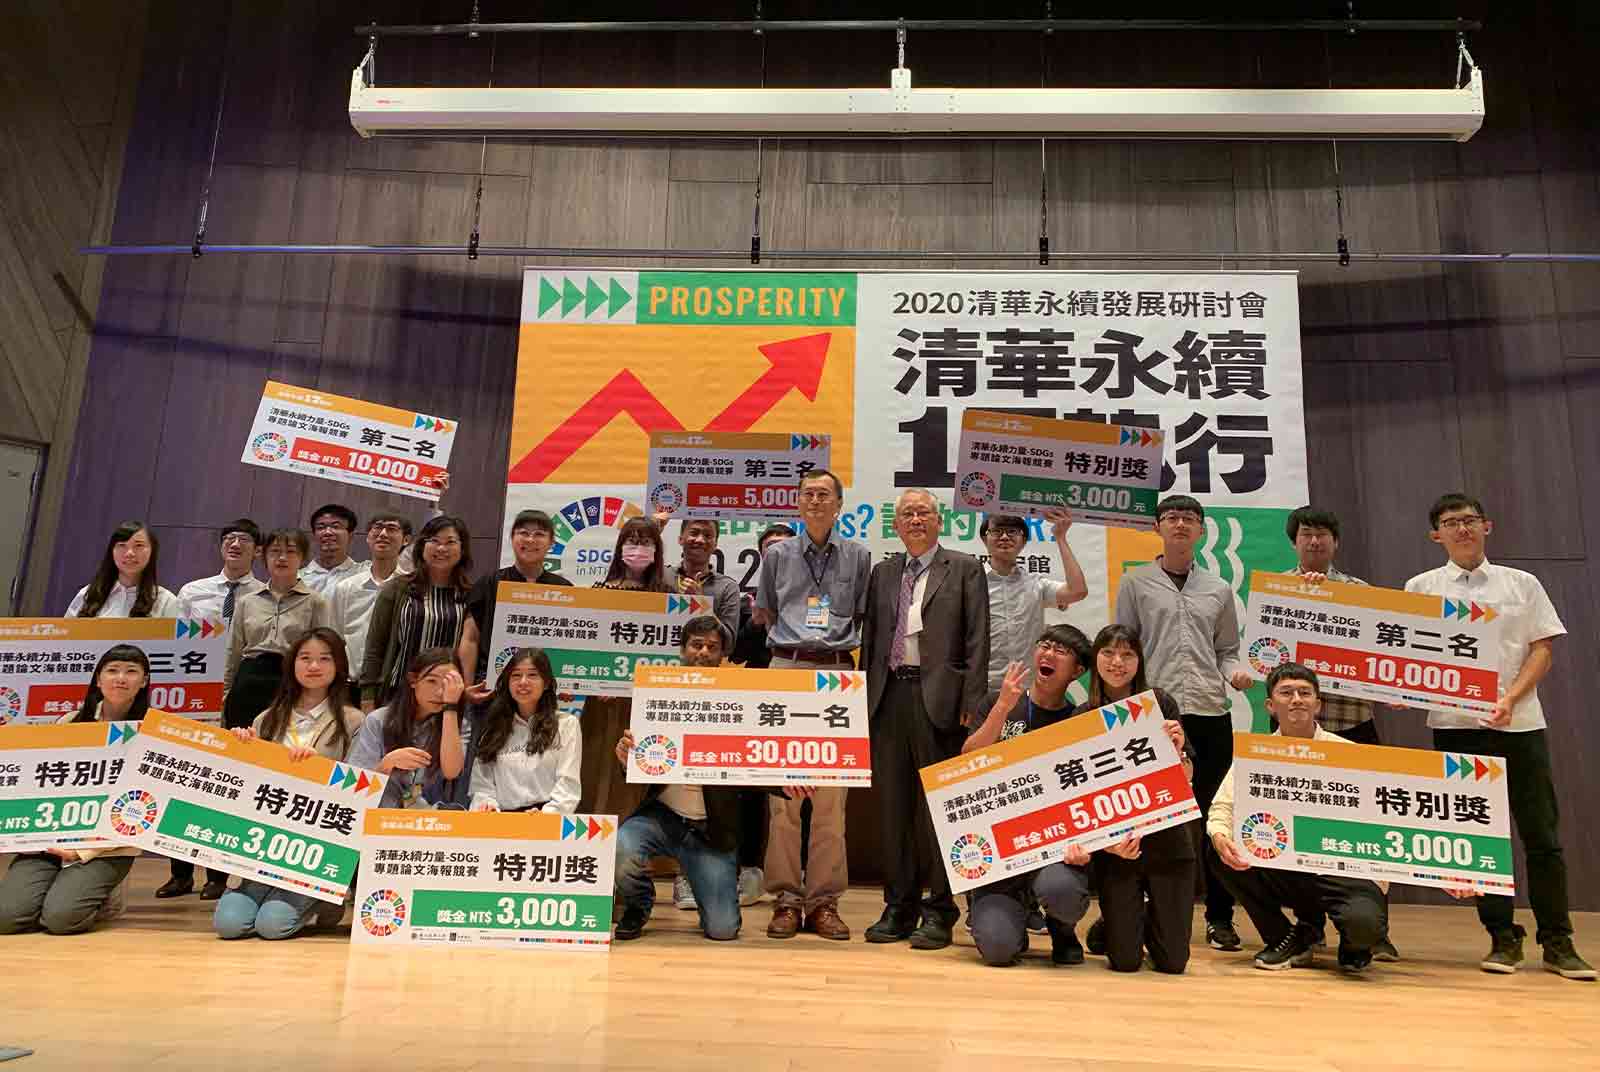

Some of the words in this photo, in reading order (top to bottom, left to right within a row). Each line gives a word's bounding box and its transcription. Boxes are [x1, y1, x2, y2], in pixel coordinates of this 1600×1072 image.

[650, 286, 846, 318] PROSPERITY
[892, 288, 1268, 320] 2020清華永續發展研討會
[892, 326, 1271, 401] 清華永續
[359, 426, 438, 460] 第二名
[348, 450, 419, 481] 10,000
[420, 475, 433, 486] 元
[1064, 451, 1150, 480] 特別獎
[1068, 484, 1131, 510] 3,000
[1133, 501, 1147, 512] 元
[576, 566, 585, 575] in
[577, 549, 612, 563] SDG
[1375, 621, 1480, 660] 第二名
[0, 652, 97, 662] 華永續力量-SDGs
[0, 663, 96, 673] 題論文海報競賽
[149, 651, 208, 674] 三名
[1365, 656, 1461, 692] 10,000
[1465, 684, 1482, 697] 元
[757, 702, 850, 729] 第一名
[142, 749, 246, 789] 清華永續力量-SDGs
[745, 739, 838, 767] 30,000
[842, 753, 857, 766] 元
[1053, 736, 1158, 792] 第三名
[943, 772, 1042, 813] 清華永續力量-SDGs
[1248, 771, 1361, 795] 清華永續力量-SDGs
[35, 800, 100, 831] 3,00
[253, 783, 358, 836] 特別獎
[1069, 783, 1151, 831] 5,000
[1155, 789, 1174, 805] 元
[1375, 786, 1492, 825] 特別獎
[242, 827, 325, 871] 3,000
[321, 863, 340, 878] 元
[375, 848, 480, 864] 清華永續力量-SDGs
[1385, 831, 1473, 866] 3,000
[1479, 855, 1497, 870] 元
[493, 852, 599, 884] 特別獎
[496, 897, 577, 928] 3,000
[581, 915, 597, 928] 元
